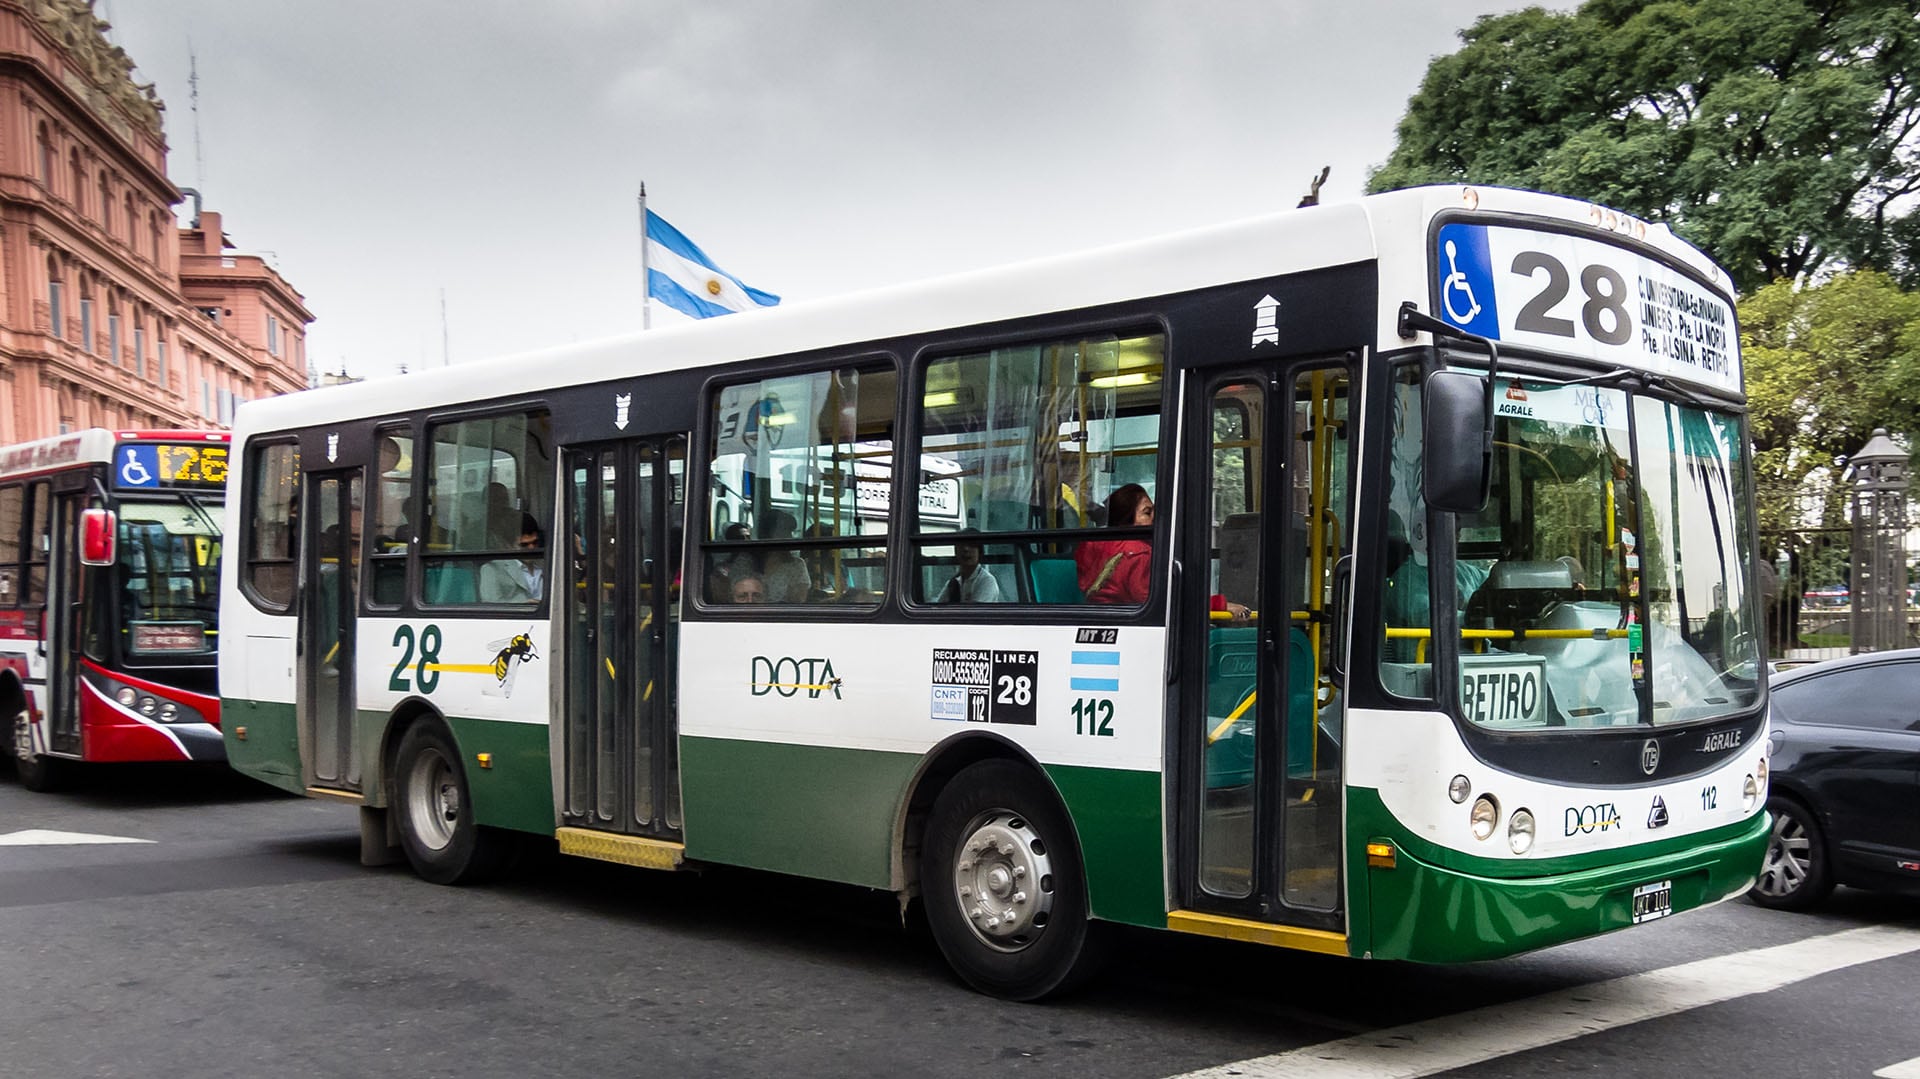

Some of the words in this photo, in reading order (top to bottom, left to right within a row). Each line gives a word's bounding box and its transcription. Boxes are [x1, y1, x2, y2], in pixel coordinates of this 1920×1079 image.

[1511, 251, 1632, 345] 28
[1640, 302, 1672, 333] LINIERS
[1679, 314, 1693, 340] Pte.
[1695, 320, 1704, 344] LA
[1705, 324, 1726, 353] NORIA
[1642, 328, 1659, 354] Pte.
[1663, 334, 1696, 365] ALSINA
[1702, 347, 1728, 376] RETIRO
[1499, 403, 1533, 416] AGRALE
[1575, 388, 1614, 409] MEGA
[1583, 404, 1607, 426] CAR
[157, 445, 229, 482] 126
[1079, 629, 1098, 641] MT
[1101, 630, 1116, 642] 12
[388, 624, 442, 694] 28
[934, 651, 977, 660] RECLAMOS
[978, 652, 989, 660] AL
[995, 653, 1036, 664] LINEA
[751, 656, 842, 700] DOTA
[933, 660, 989, 684] 0800-5553682
[935, 689, 963, 699] CNRT
[997, 675, 1032, 706] 28
[1463, 671, 1537, 721] RETIRO
[972, 695, 984, 720] 112
[1071, 698, 1114, 737] 112
[1704, 731, 1742, 752] AGRALE
[1701, 786, 1717, 811] 112
[1565, 803, 1621, 837] DOTA
[1655, 890, 1670, 911] 101
